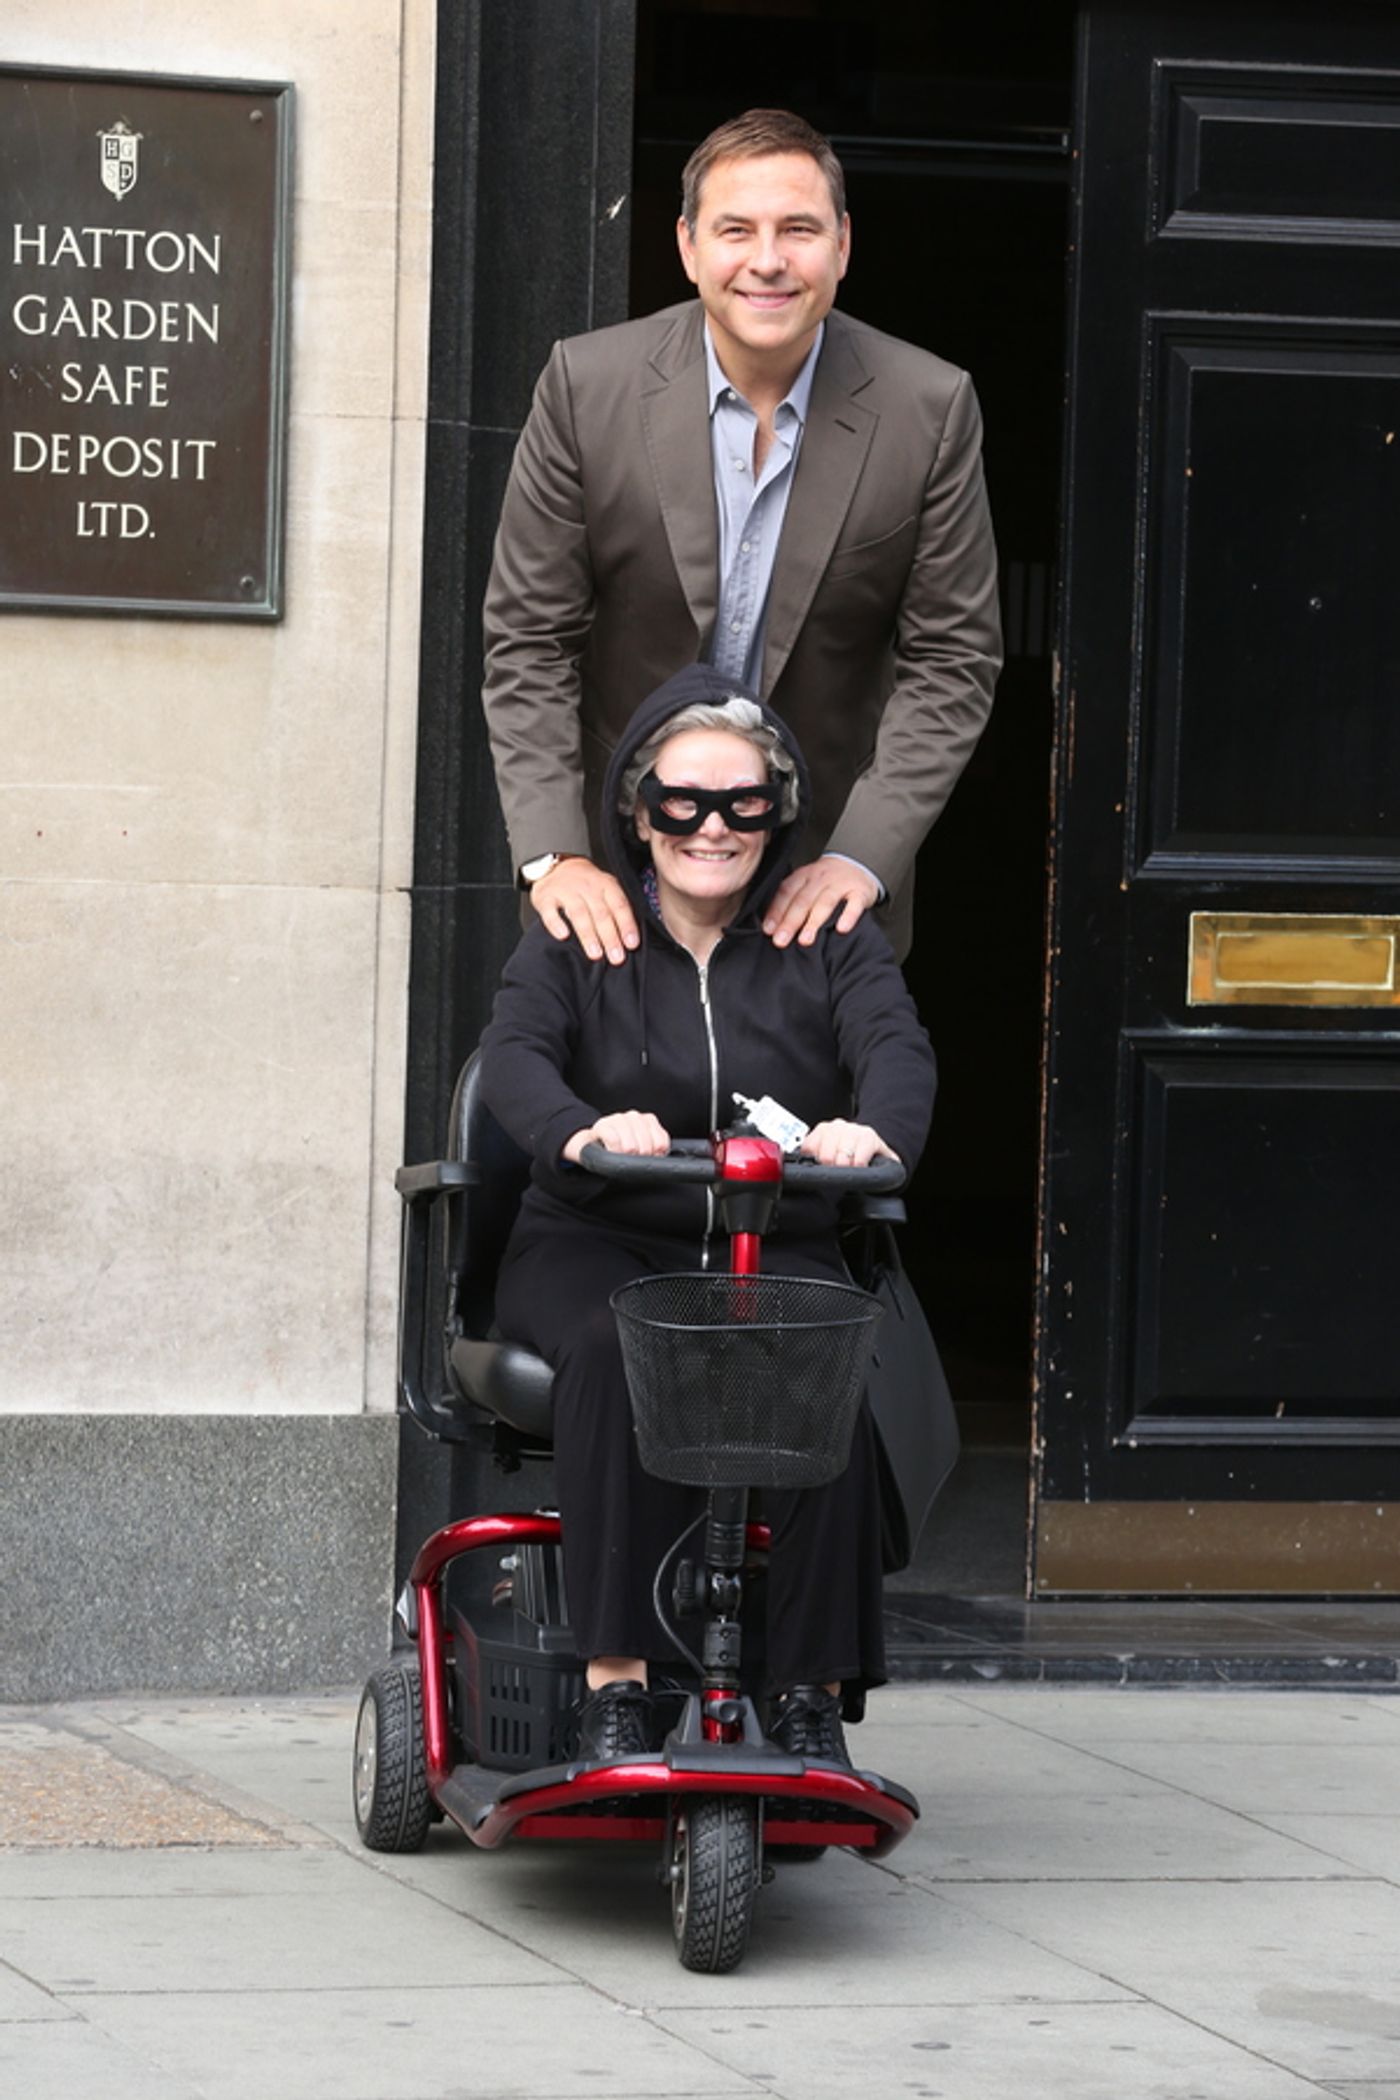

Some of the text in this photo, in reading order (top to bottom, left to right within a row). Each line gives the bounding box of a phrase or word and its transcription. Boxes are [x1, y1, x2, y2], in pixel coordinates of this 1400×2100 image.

[13, 223, 221, 275] HATTON
[13, 294, 219, 344] GARDEN
[61, 362, 169, 408] SAFE
[13, 431, 217, 480] DEPOSIT
[76, 501, 156, 538] LTD.
